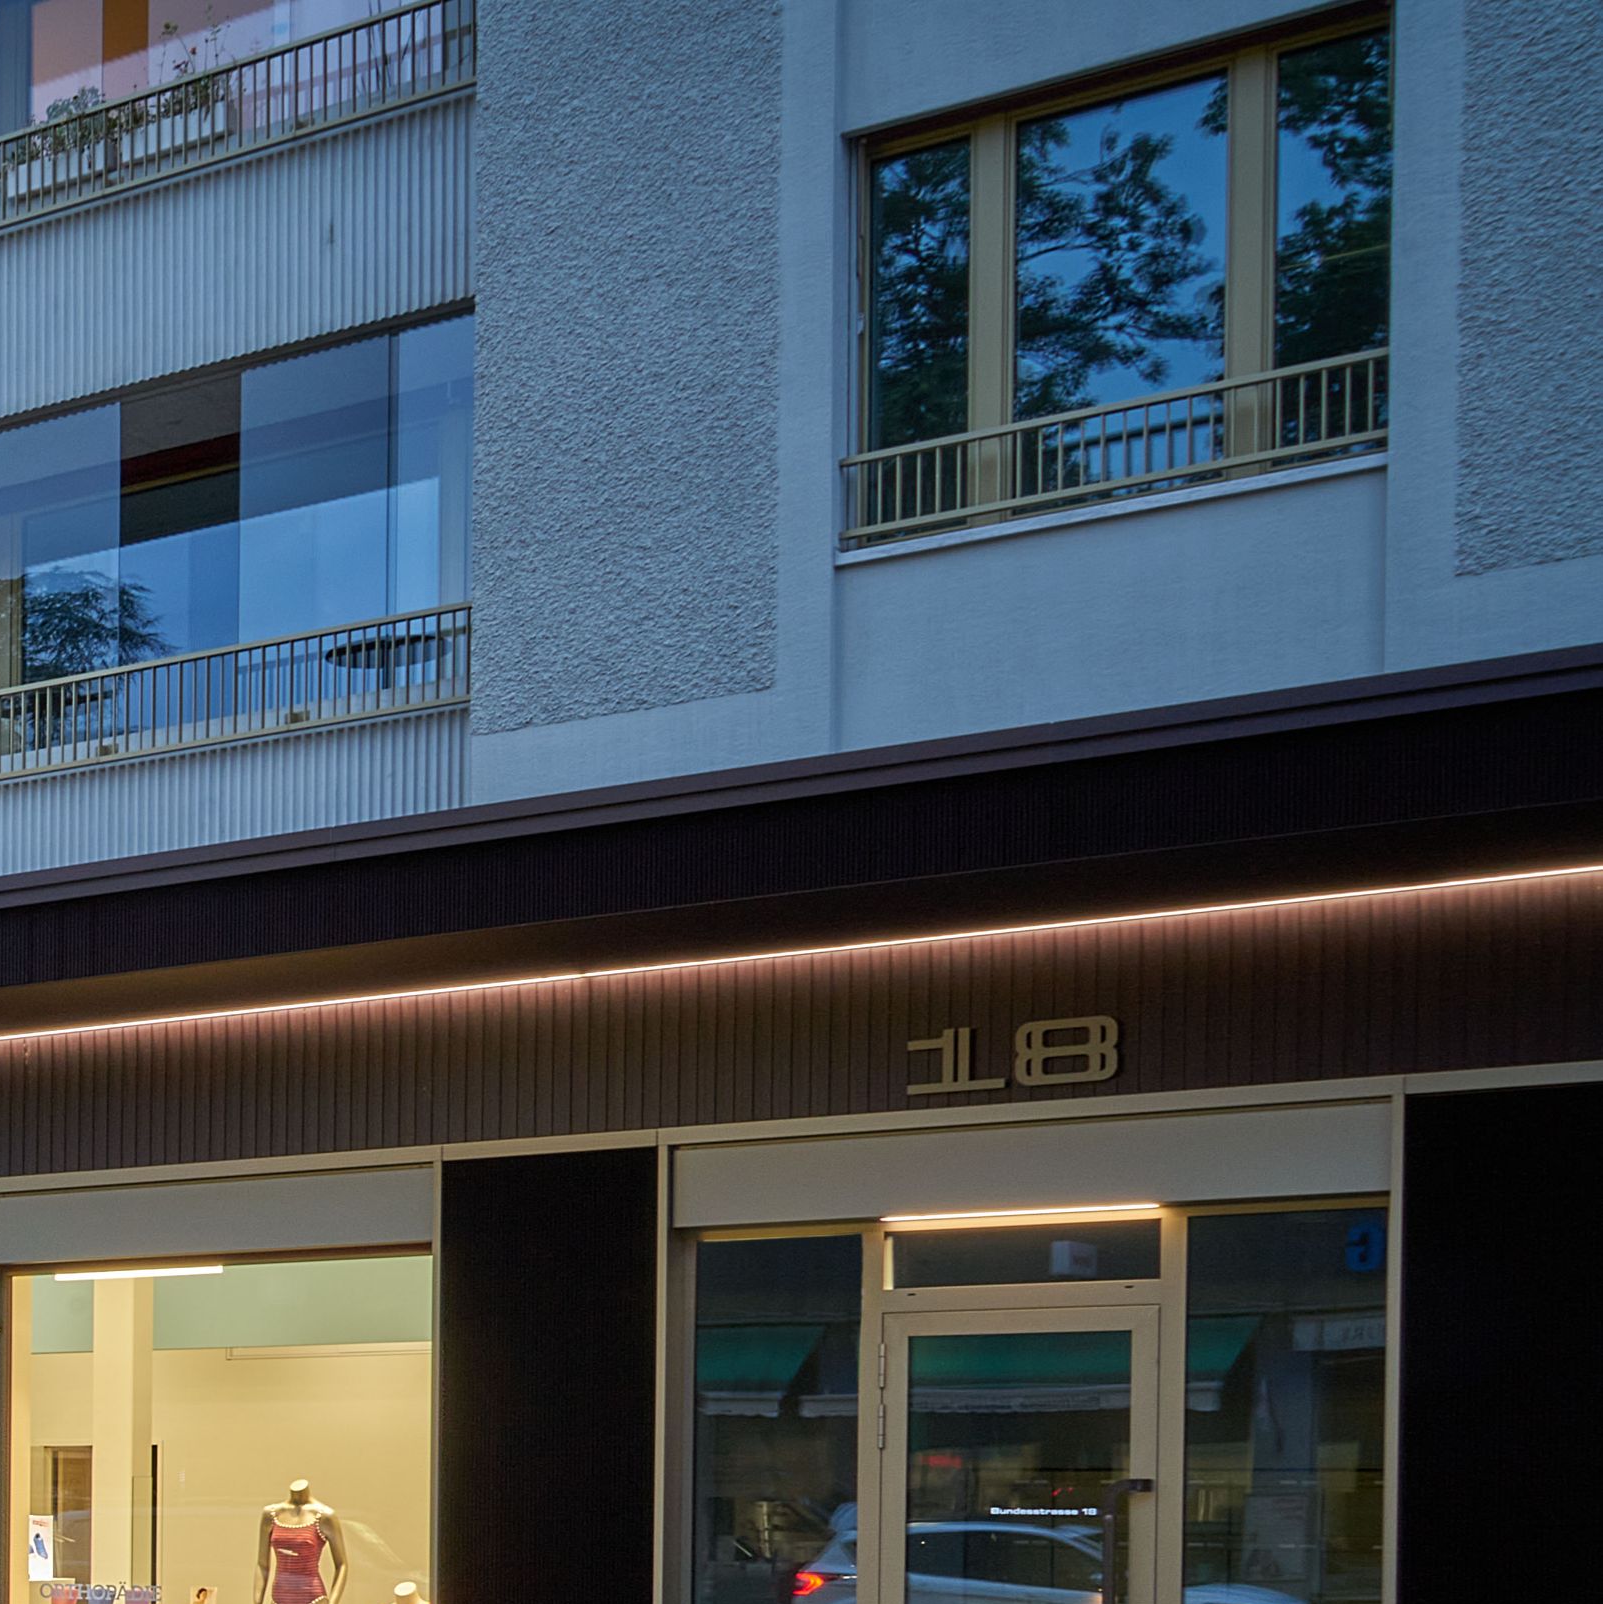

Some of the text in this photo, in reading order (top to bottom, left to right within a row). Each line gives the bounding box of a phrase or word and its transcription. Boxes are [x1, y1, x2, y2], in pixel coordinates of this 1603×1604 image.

[907, 1015, 1119, 1095] 18
[990, 1507, 1098, 1516] Bundesstrasse 18
[39, 1581, 162, 1602] ORTHOPÄDIE
